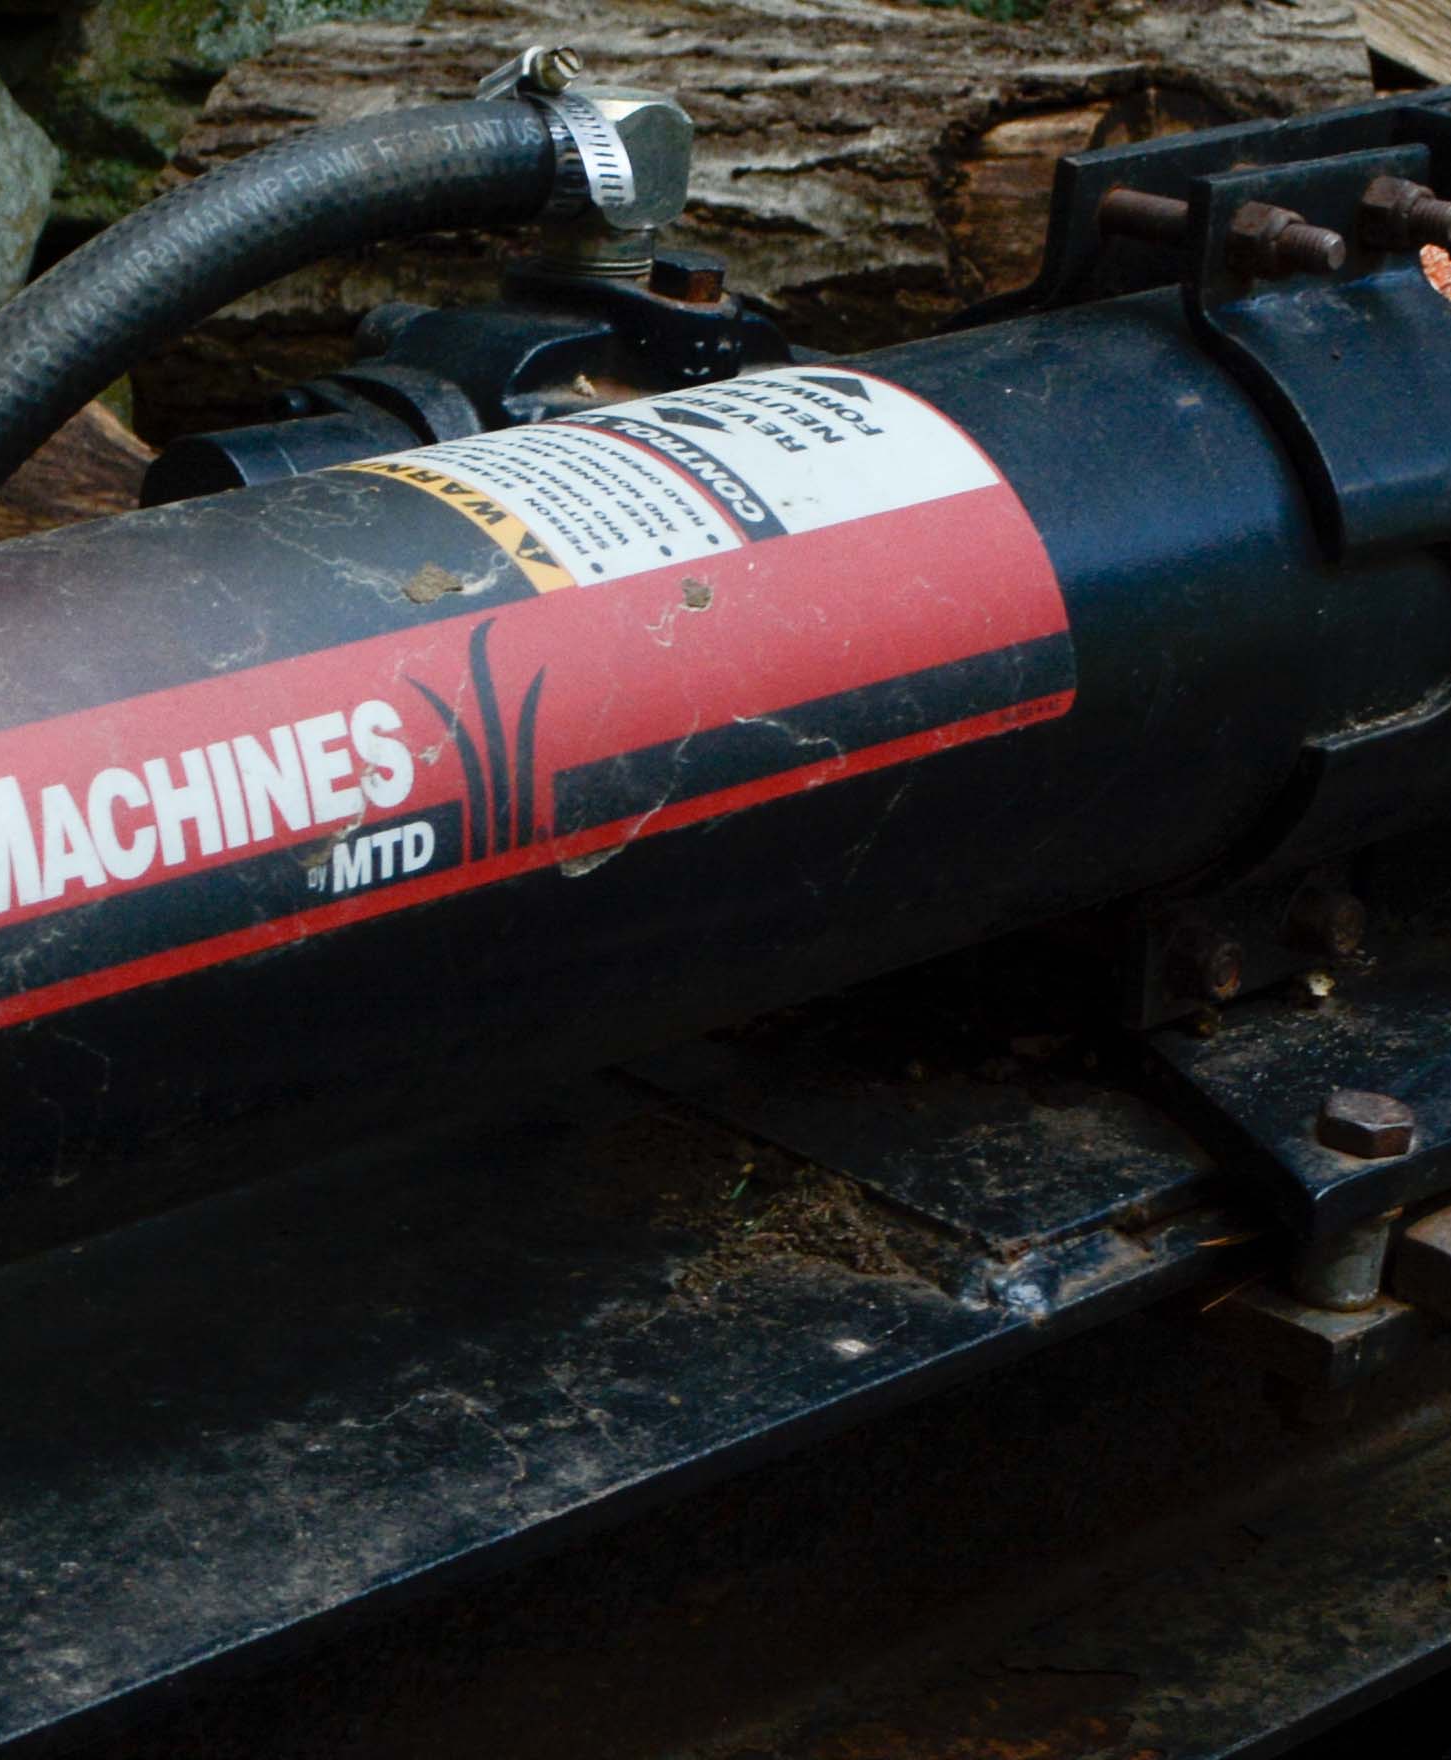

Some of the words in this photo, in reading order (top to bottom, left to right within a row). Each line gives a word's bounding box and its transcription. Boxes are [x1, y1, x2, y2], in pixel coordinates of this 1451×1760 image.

[690, 387, 844, 444] NEUTRA
[726, 378, 884, 436] FORWAR
[579, 455, 645, 499] MOVING
[612, 421, 765, 522] CONTROL
[524, 497, 590, 556] PERSON
[536, 486, 611, 551] SPLITTER
[593, 509, 630, 546] WHO
[615, 499, 659, 539] KEEP
[643, 501, 680, 533] AND
[662, 486, 705, 527] READ
[331, 821, 435, 894] MTD
